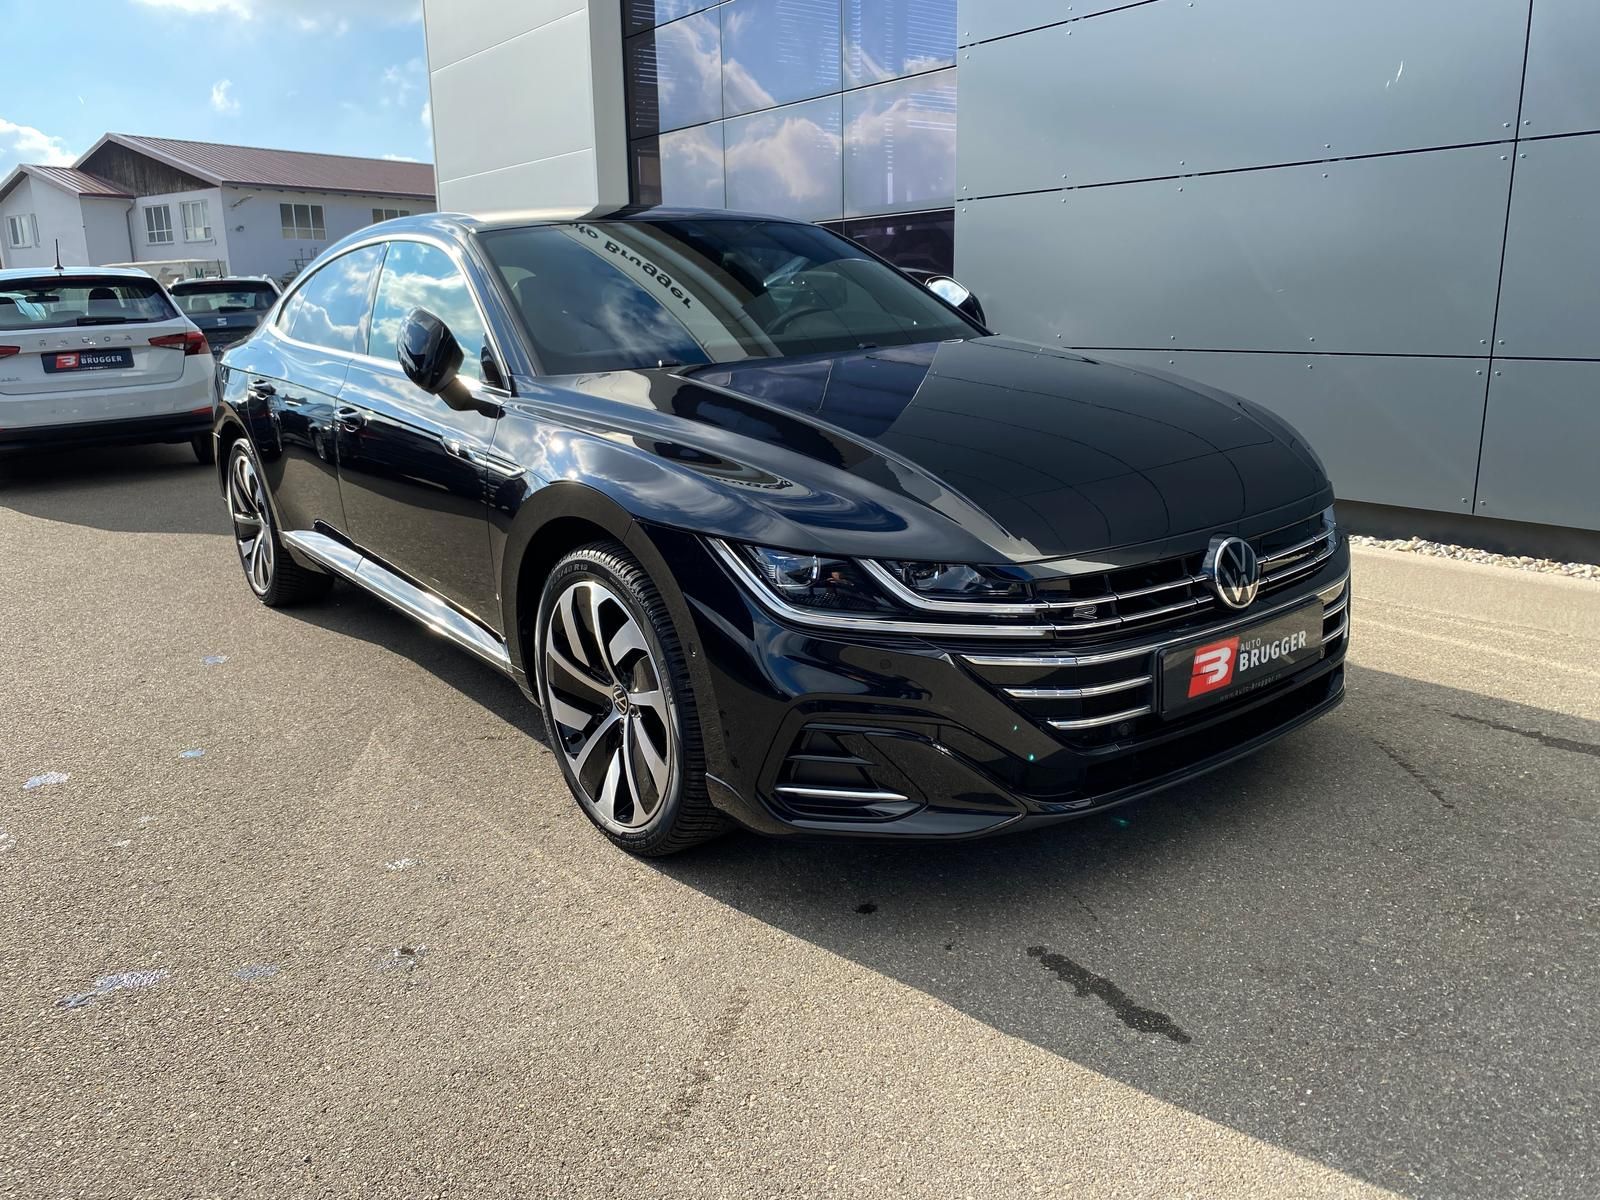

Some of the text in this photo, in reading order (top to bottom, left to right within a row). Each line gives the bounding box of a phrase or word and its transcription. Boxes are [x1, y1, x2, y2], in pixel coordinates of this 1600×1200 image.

[80, 355, 123, 364] BRUGGER
[1239, 630, 1307, 672] BRUGGER
[1240, 638, 1261, 653] AUTO
